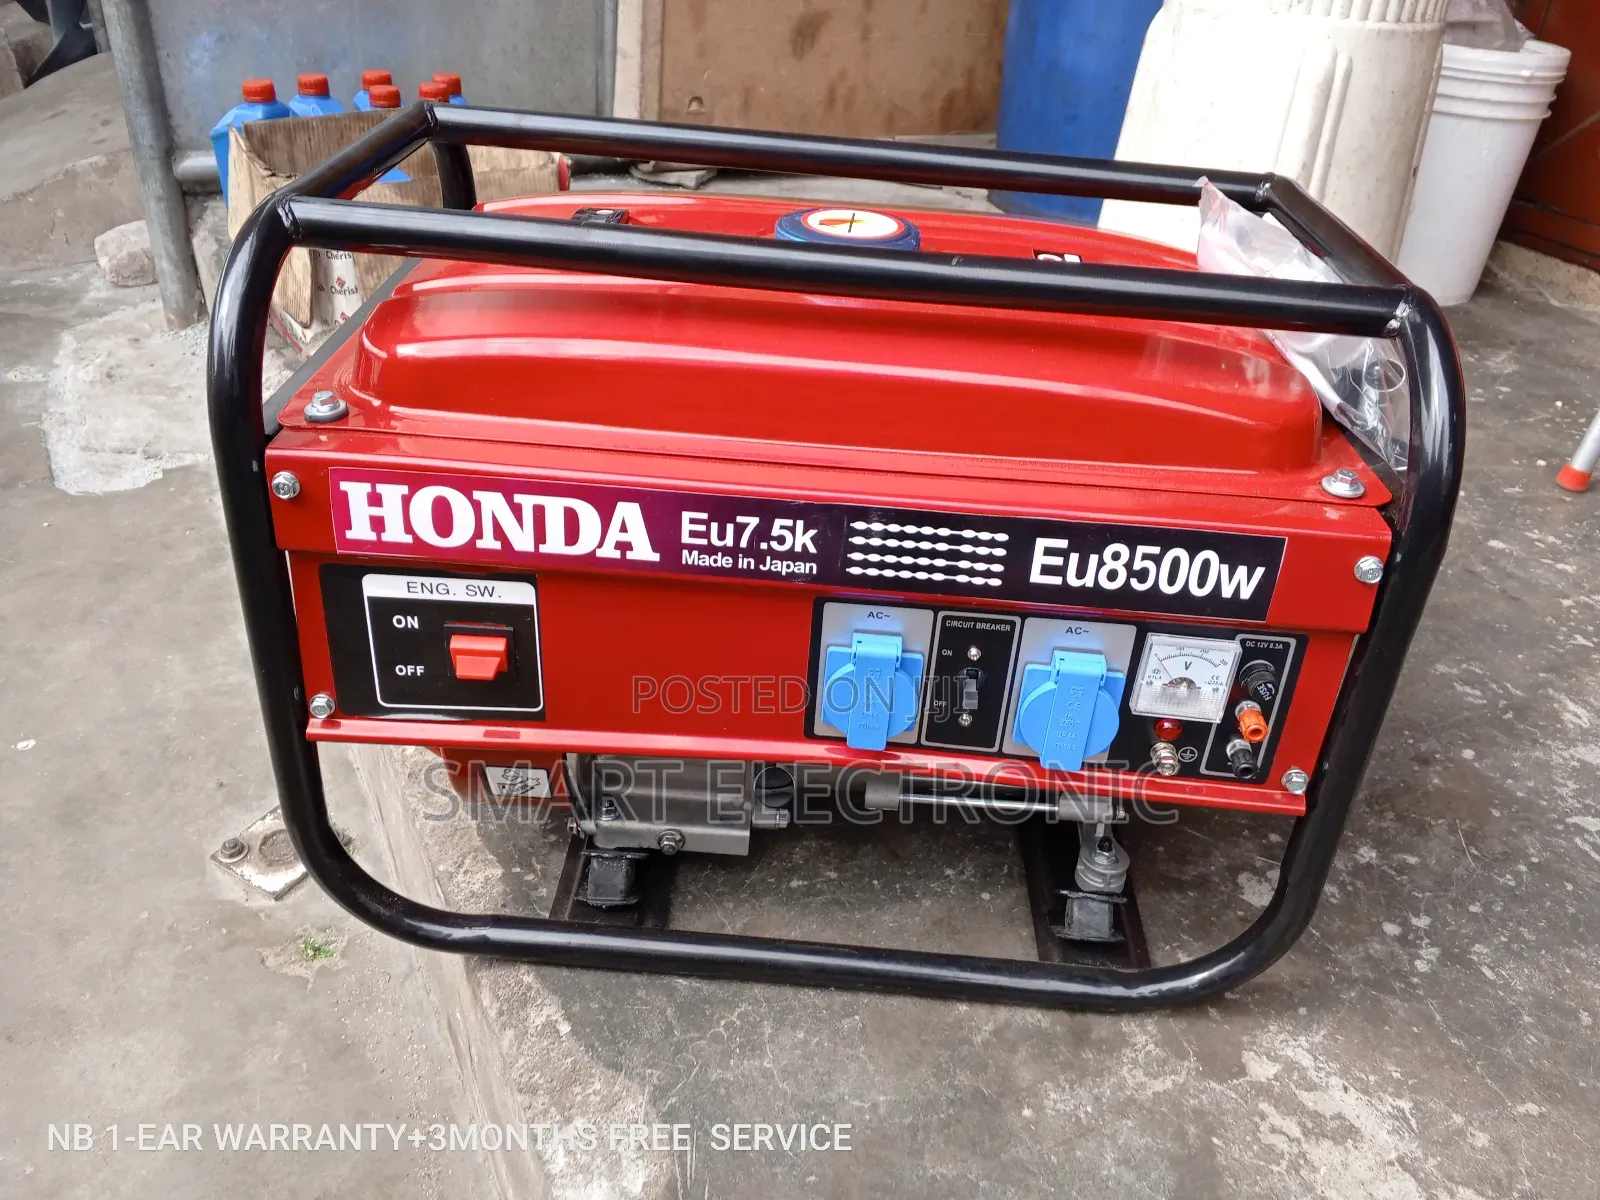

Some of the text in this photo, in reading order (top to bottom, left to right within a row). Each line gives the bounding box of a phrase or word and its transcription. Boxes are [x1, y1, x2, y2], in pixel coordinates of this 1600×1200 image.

[339, 481, 660, 562] HONDA
[680, 511, 818, 554] Eu7.5k
[681, 548, 818, 577] Made in Japan
[1029, 537, 1266, 600] Eu8500w
[406, 580, 502, 599] ENG. SW.
[392, 615, 419, 629] ON
[946, 620, 1011, 631] CIRCUIT BREAKER
[942, 649, 953, 657] ON
[395, 664, 425, 677] OFF
[1184, 661, 1193, 671] V
[1256, 683, 1272, 701] FUSE
